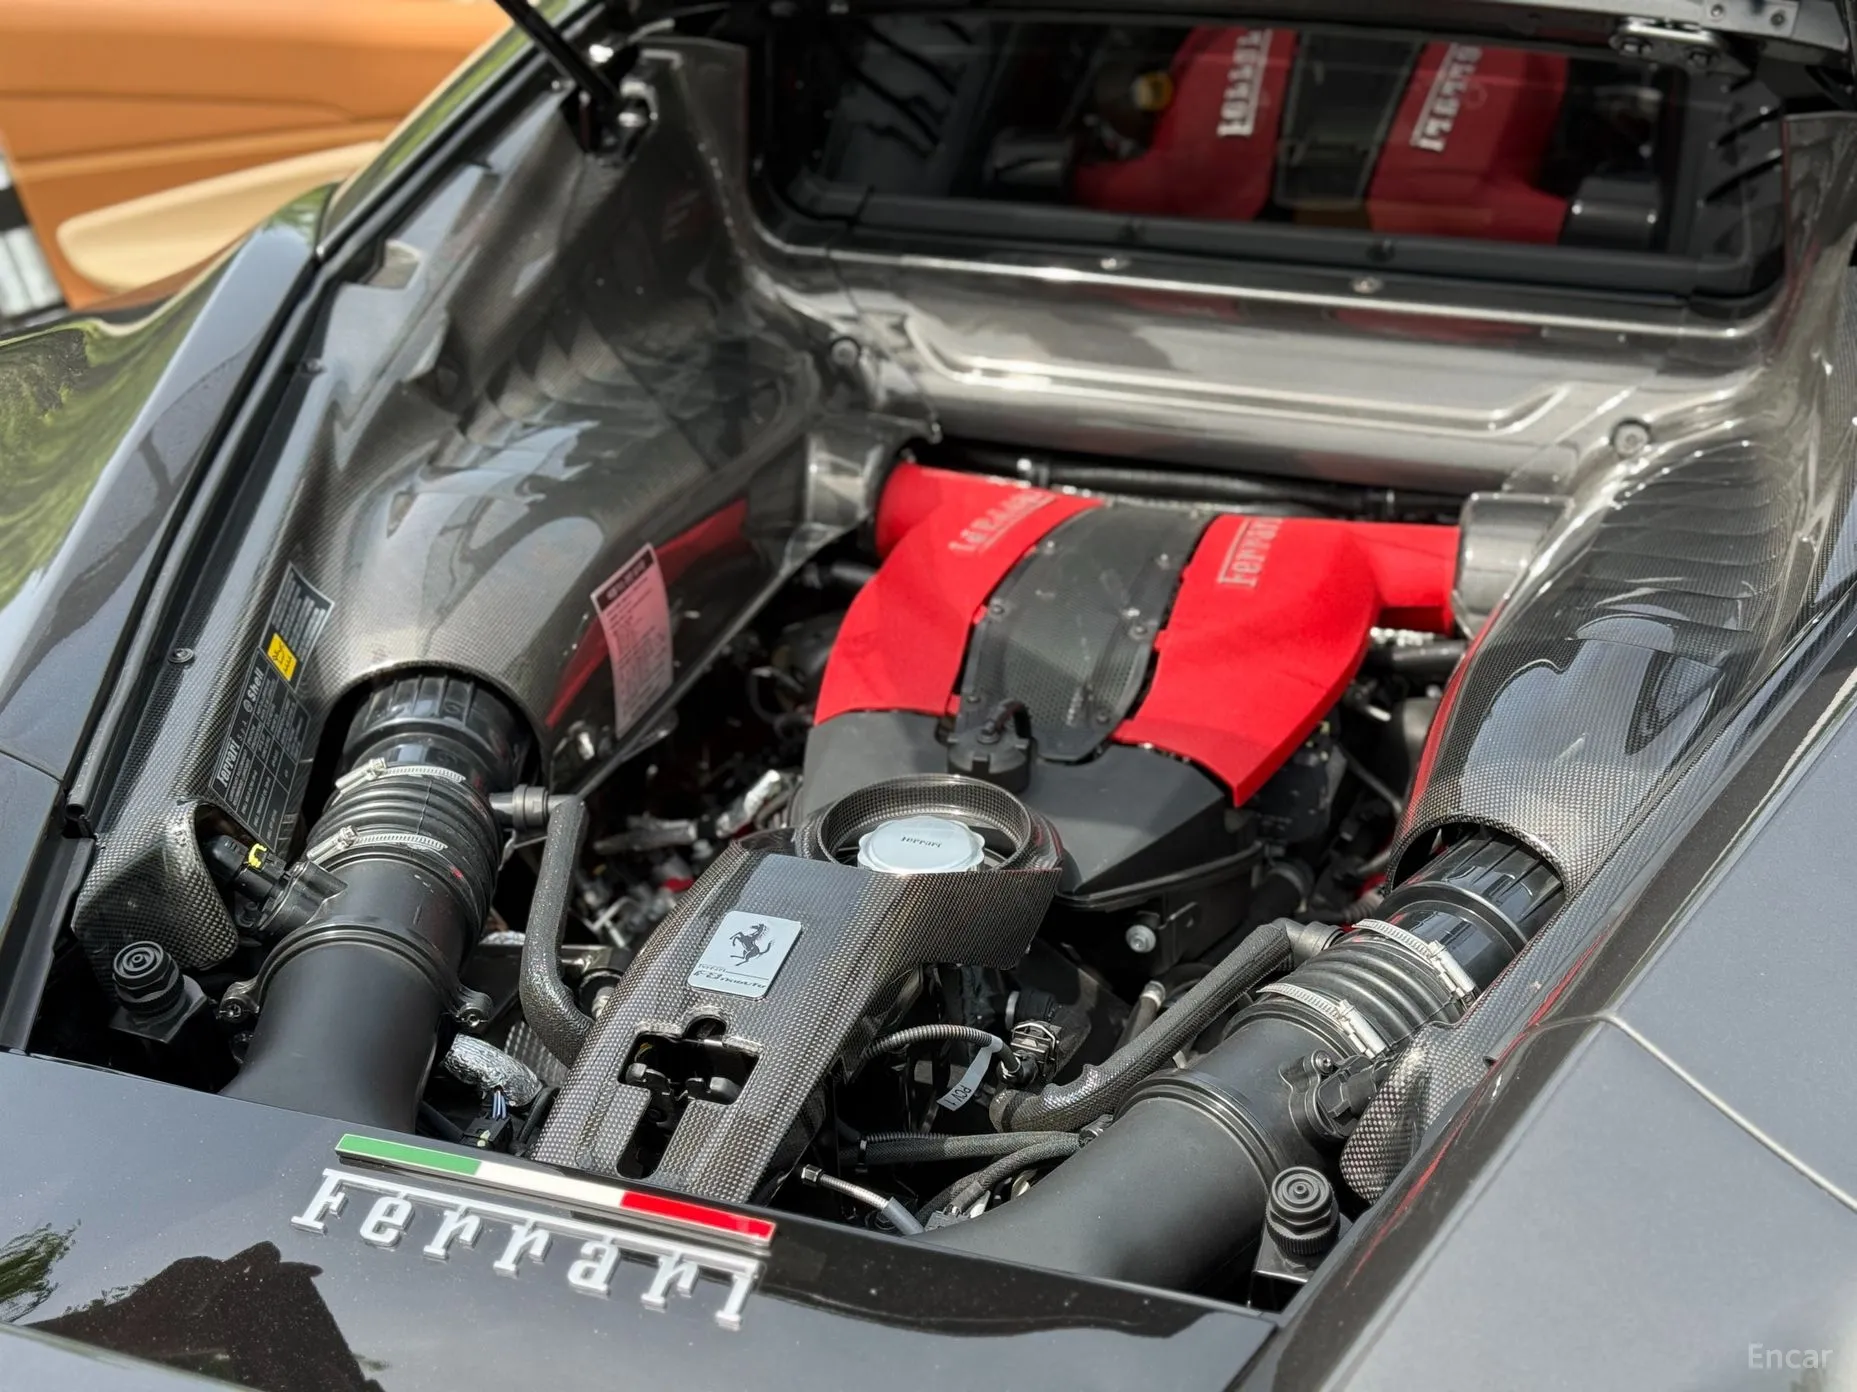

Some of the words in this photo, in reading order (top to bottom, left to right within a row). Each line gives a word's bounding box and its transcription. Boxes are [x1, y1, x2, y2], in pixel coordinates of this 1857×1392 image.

[216, 737, 241, 788] Ferrari
[247, 666, 265, 702] Shell
[951, 1084, 972, 1103] PCV
[290, 1167, 764, 1328] Ferrari
